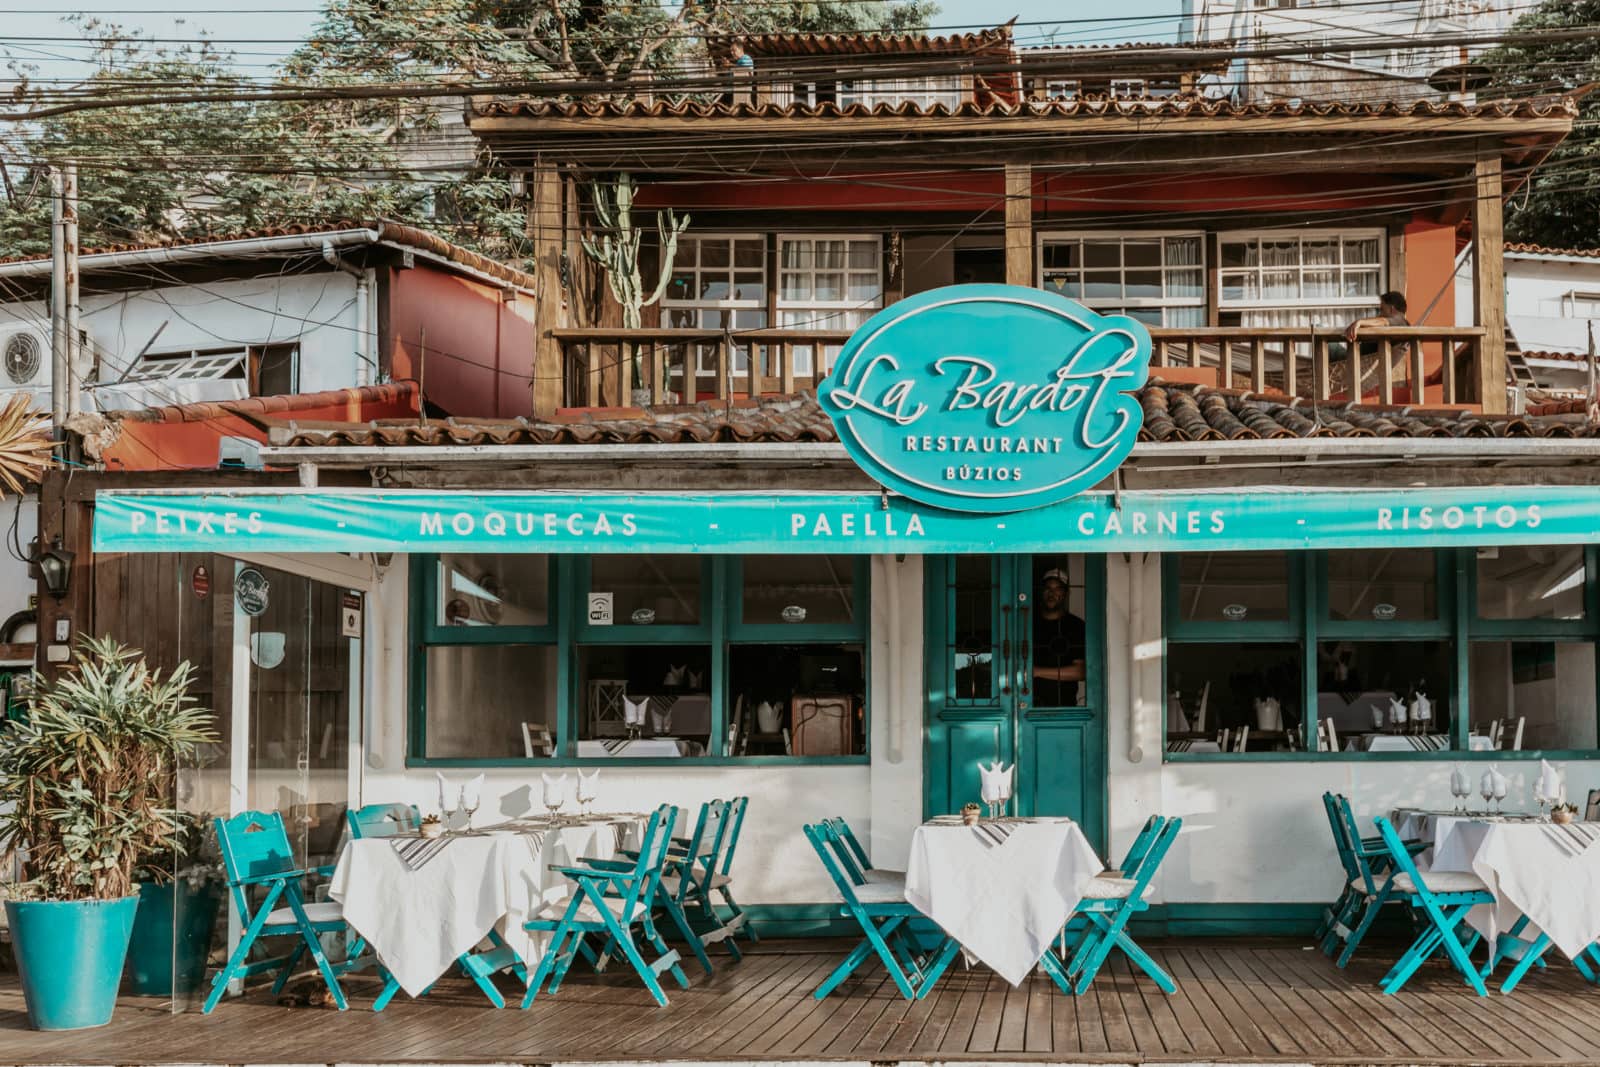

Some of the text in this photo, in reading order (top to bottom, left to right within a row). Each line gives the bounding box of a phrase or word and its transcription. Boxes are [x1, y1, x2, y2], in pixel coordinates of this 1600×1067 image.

[830, 329, 1138, 448] La Bardot
[906, 436, 1063, 452] RESTAURANT
[946, 466, 1022, 480] BÚZIOS
[130, 511, 264, 534] PEIXES
[419, 513, 638, 536] MOQUECAS
[791, 513, 925, 536] PAELLA
[1078, 511, 1225, 535] CARNES
[1377, 504, 1542, 530] RISOTOS
